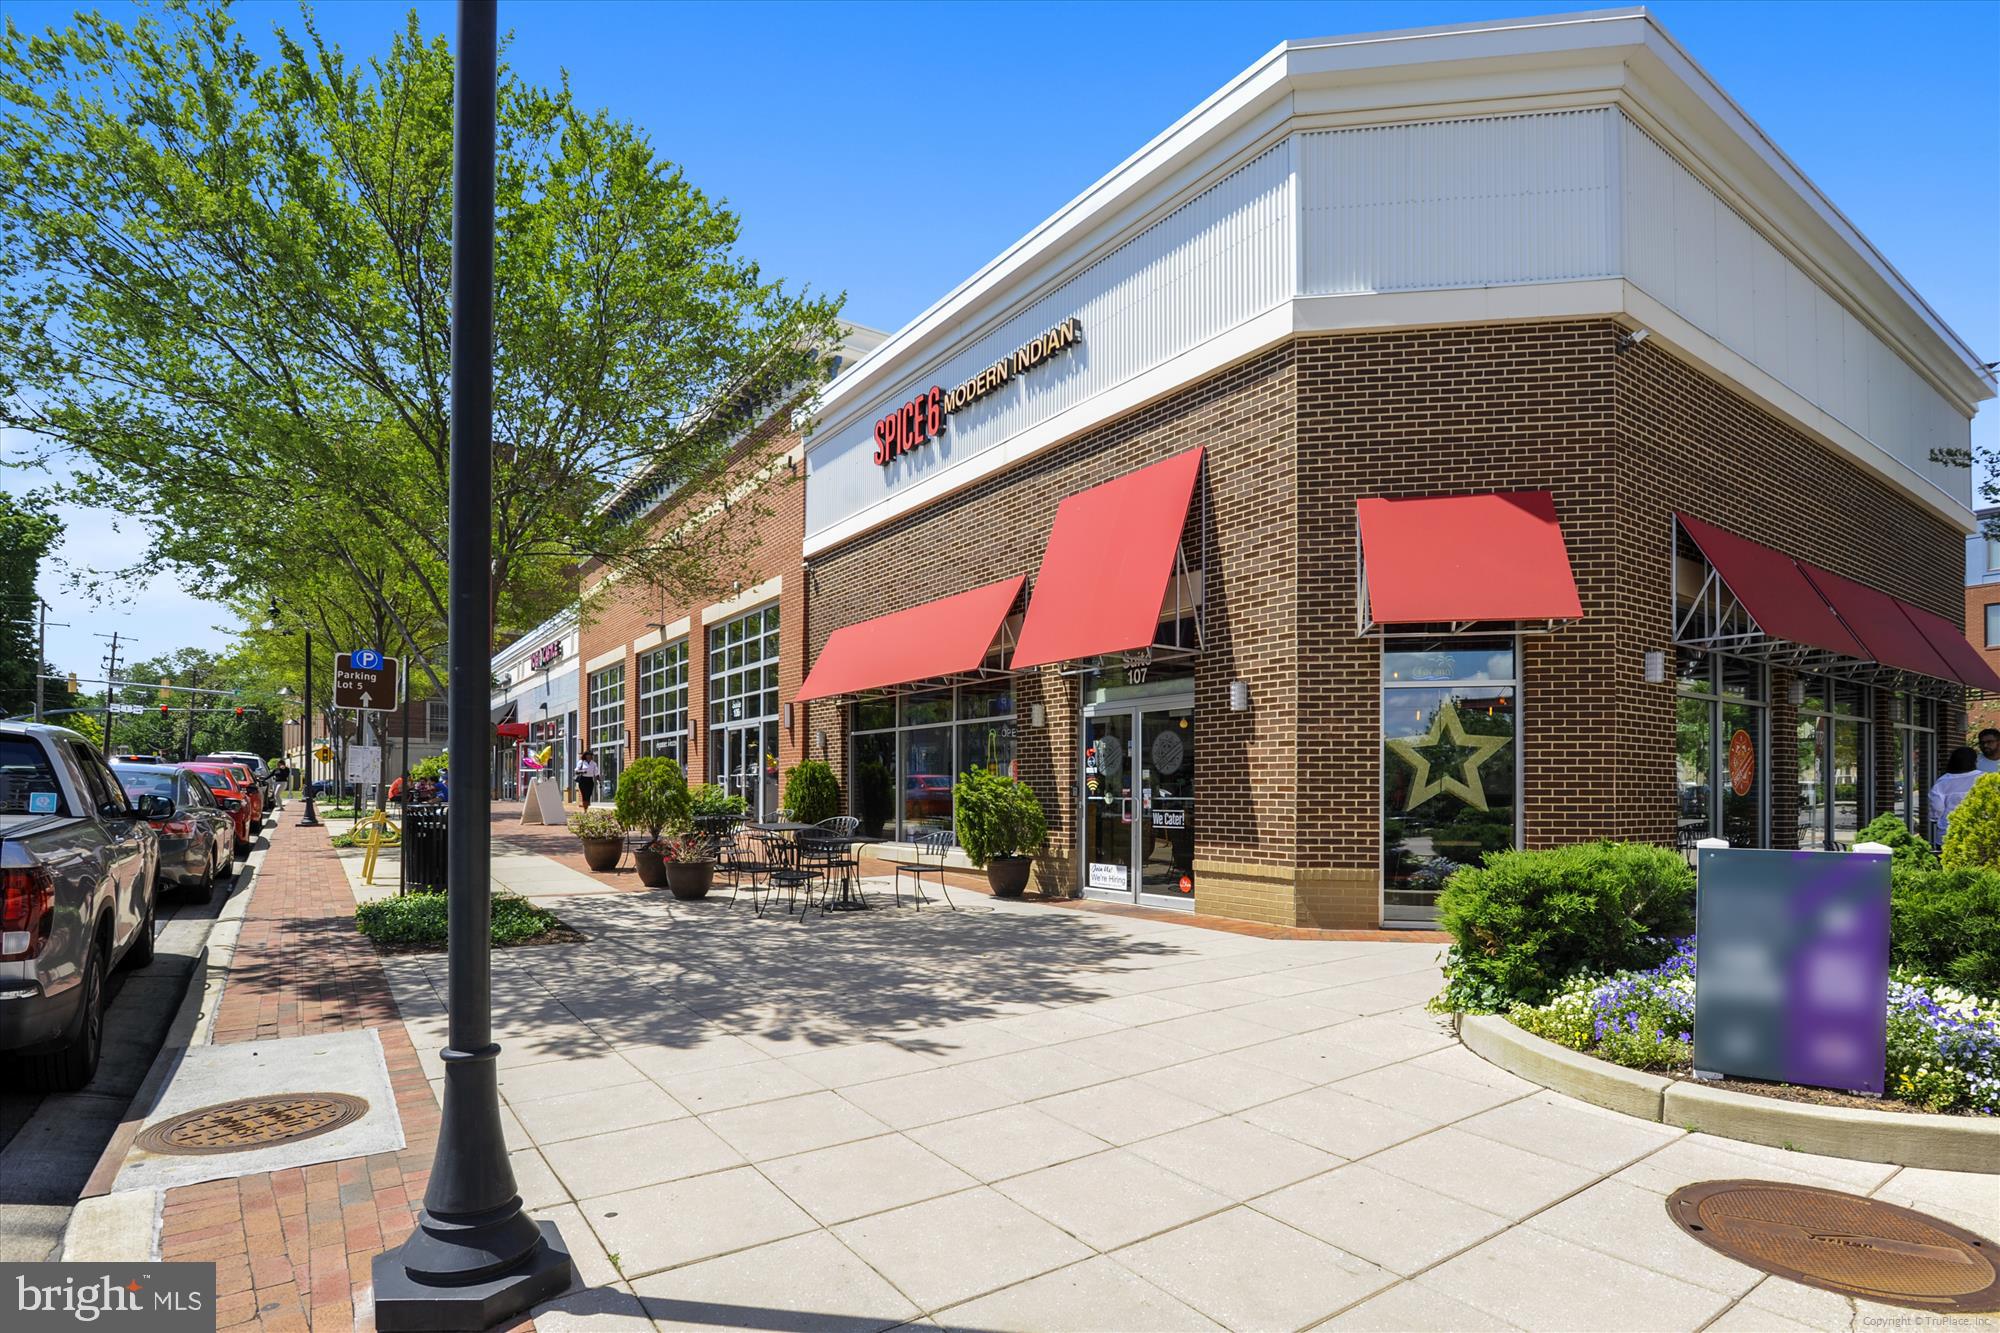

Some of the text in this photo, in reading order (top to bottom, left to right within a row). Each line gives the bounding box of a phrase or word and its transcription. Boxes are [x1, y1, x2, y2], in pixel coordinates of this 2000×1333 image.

[873, 318, 1078, 466] SPICE 6 MODERN INDIAN
[337, 670, 377, 683] Parking
[1127, 668, 1148, 684] 107
[337, 680, 353, 689] Lot
[1001, 728, 1017, 737] OPE
[1152, 812, 1185, 826] We Cater!
[1092, 864, 1103, 873] Join
[1091, 873, 1107, 881] We're
[1108, 874, 1126, 886] Hiring
